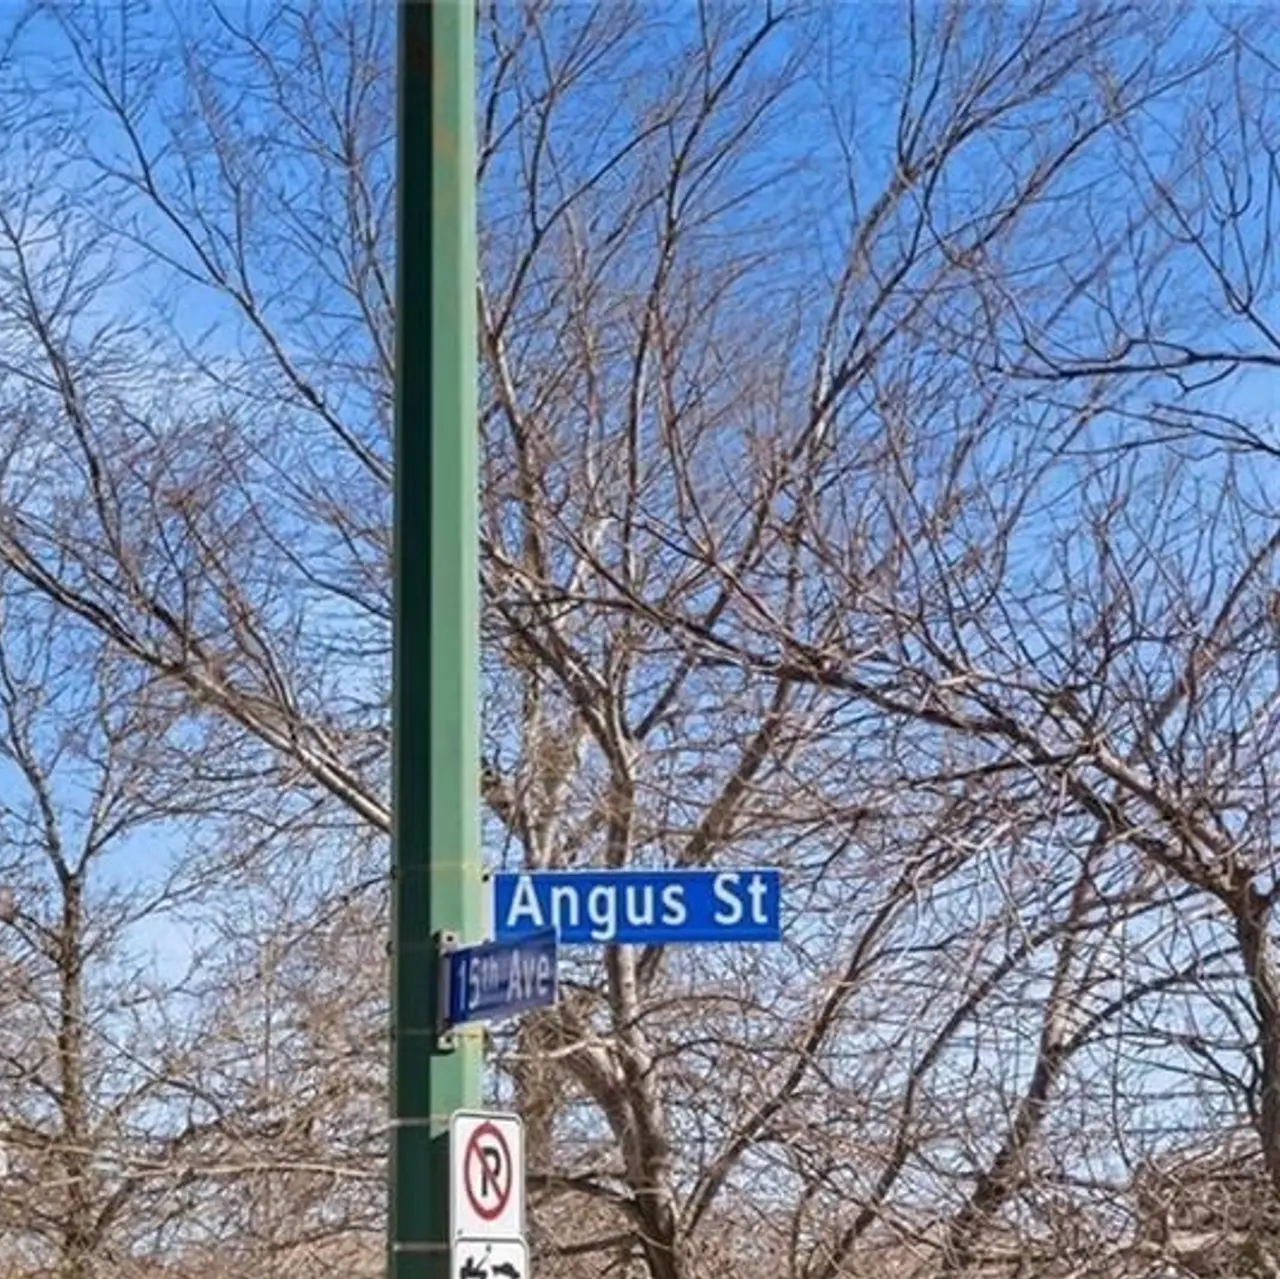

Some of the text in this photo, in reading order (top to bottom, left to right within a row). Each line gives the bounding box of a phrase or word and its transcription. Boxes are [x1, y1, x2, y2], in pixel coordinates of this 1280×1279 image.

[506, 873, 768, 940] Angus St
[458, 948, 549, 1012] 15th Ave
